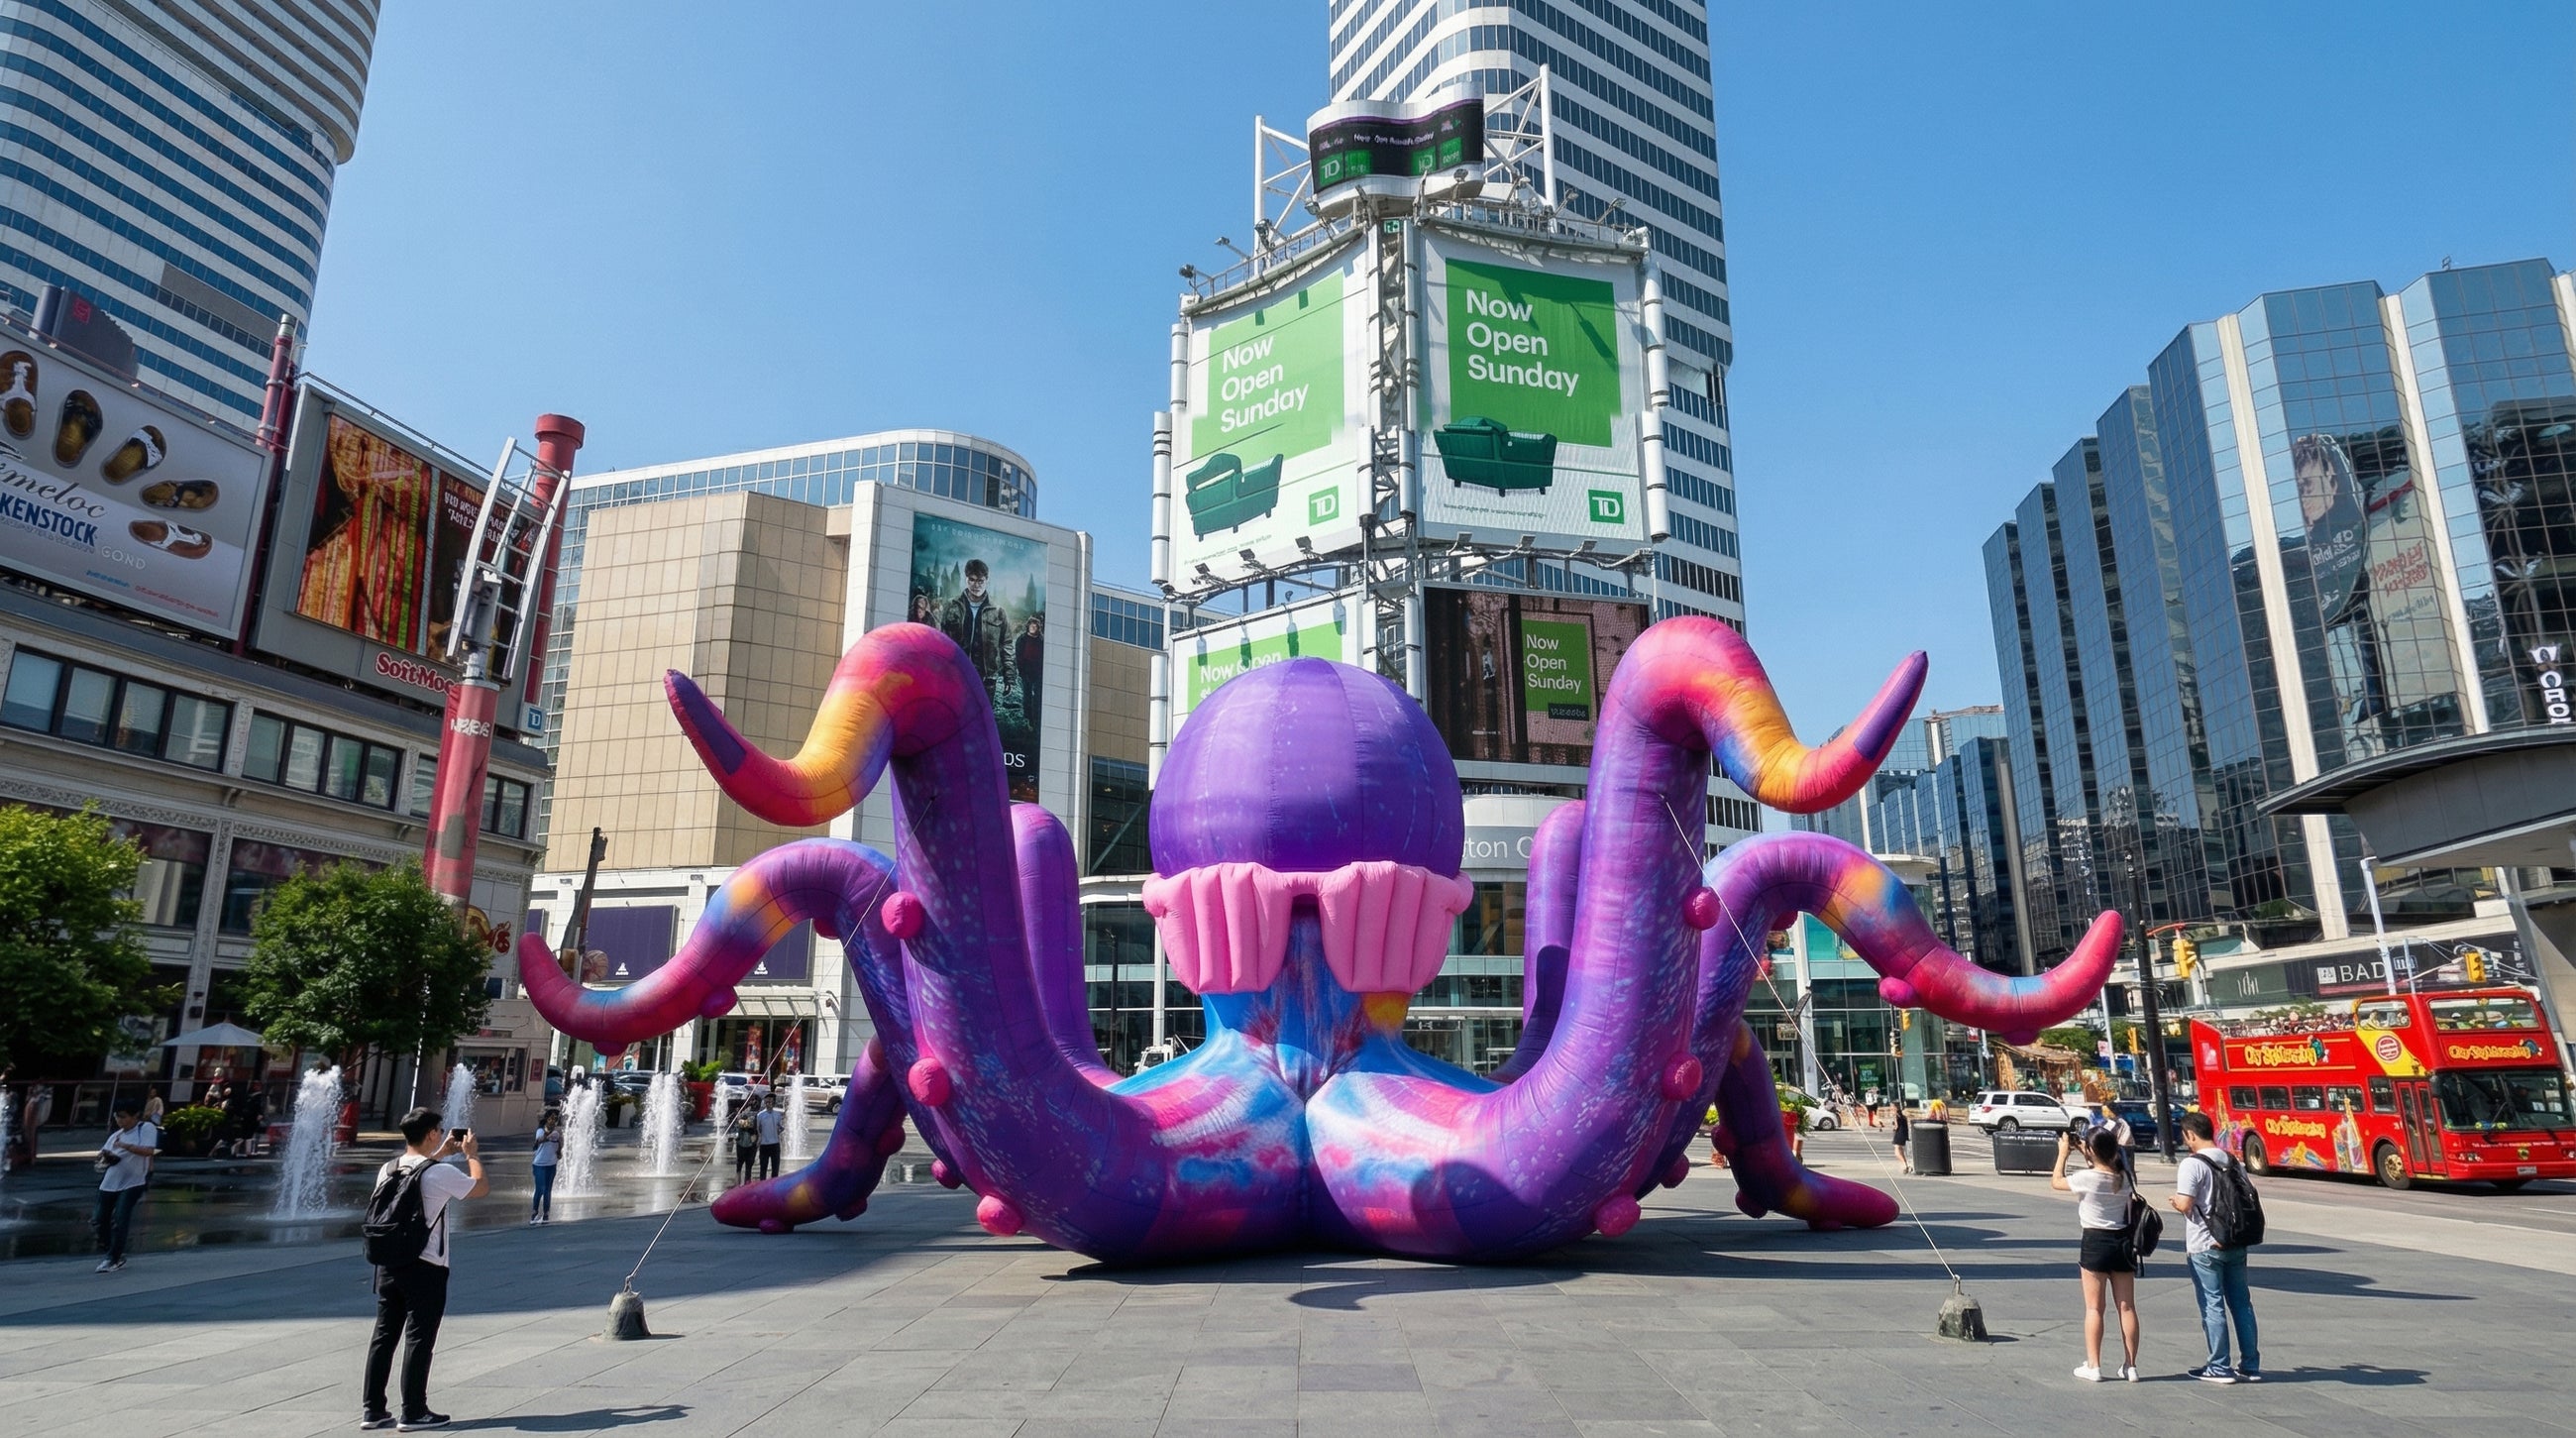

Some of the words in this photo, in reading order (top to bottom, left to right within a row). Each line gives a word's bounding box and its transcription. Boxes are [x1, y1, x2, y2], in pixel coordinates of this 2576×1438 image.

[1321, 159, 1341, 179] TD
[1466, 288, 1533, 322] Now
[1466, 321, 1548, 356] Open
[1223, 335, 1276, 374] Now
[1221, 364, 1283, 402] Open
[1467, 354, 1579, 397] Sunday
[1220, 384, 1309, 434] Sunday
[1311, 494, 1336, 518] TD
[1592, 497, 1621, 518] TD
[1526, 634, 1559, 650] Now
[1200, 663, 1234, 684] Now
[1526, 654, 1566, 672] Open
[1528, 673, 1582, 695] Sunday
